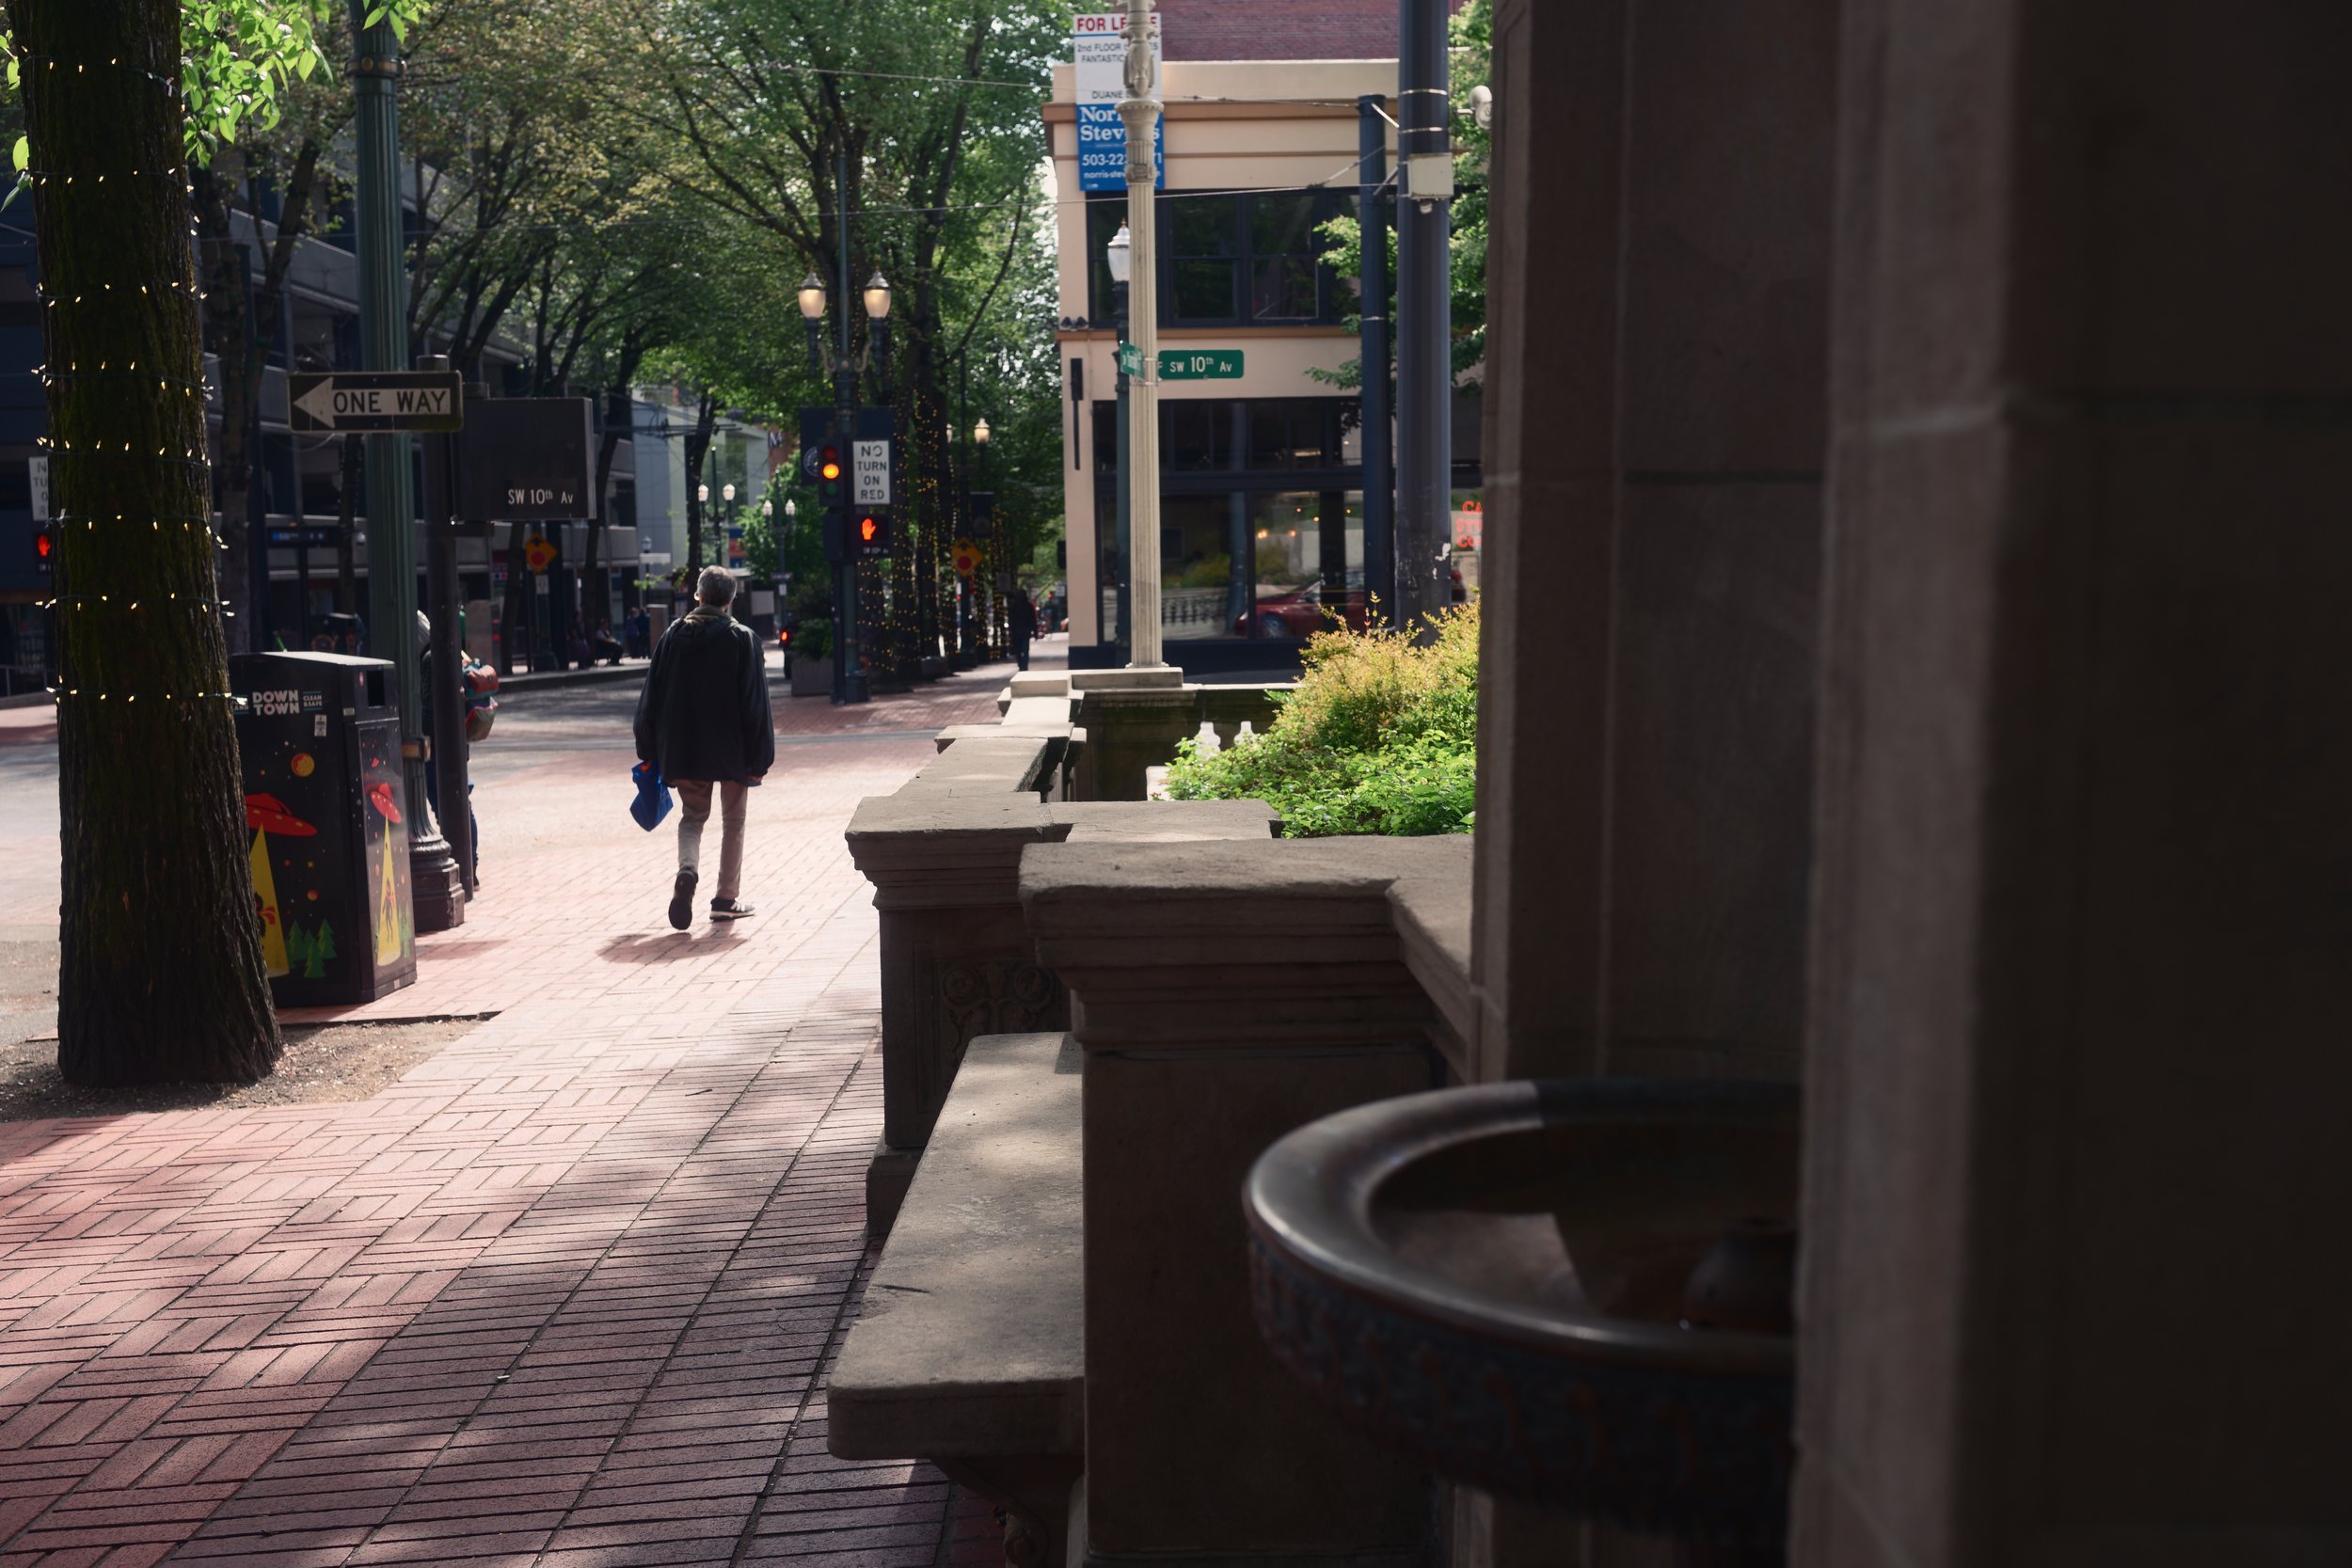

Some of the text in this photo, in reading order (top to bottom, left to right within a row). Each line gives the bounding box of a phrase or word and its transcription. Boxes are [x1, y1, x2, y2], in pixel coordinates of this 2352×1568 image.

[1077, 16, 1157, 31] FOR LEE
[1077, 44, 1092, 53] 2nd
[1094, 42, 1121, 52] FLOOR
[1081, 54, 1124, 63] FANTASTIC
[1091, 90, 1123, 100] DUANE
[1079, 106, 1122, 123] Nor
[1080, 124, 1160, 142] Stevs
[1169, 361, 1184, 372] SW
[1190, 356, 1215, 372] 10th
[1219, 361, 1232, 372] Av
[333, 390, 446, 413] ONE WAY
[861, 445, 882, 457] NO
[856, 461, 887, 471] TURN
[864, 475, 880, 485] ON
[507, 489, 573, 504] SW 10th Av
[861, 489, 884, 499] RED
[252, 689, 299, 704] DOWN
[253, 703, 300, 716] TOWN
